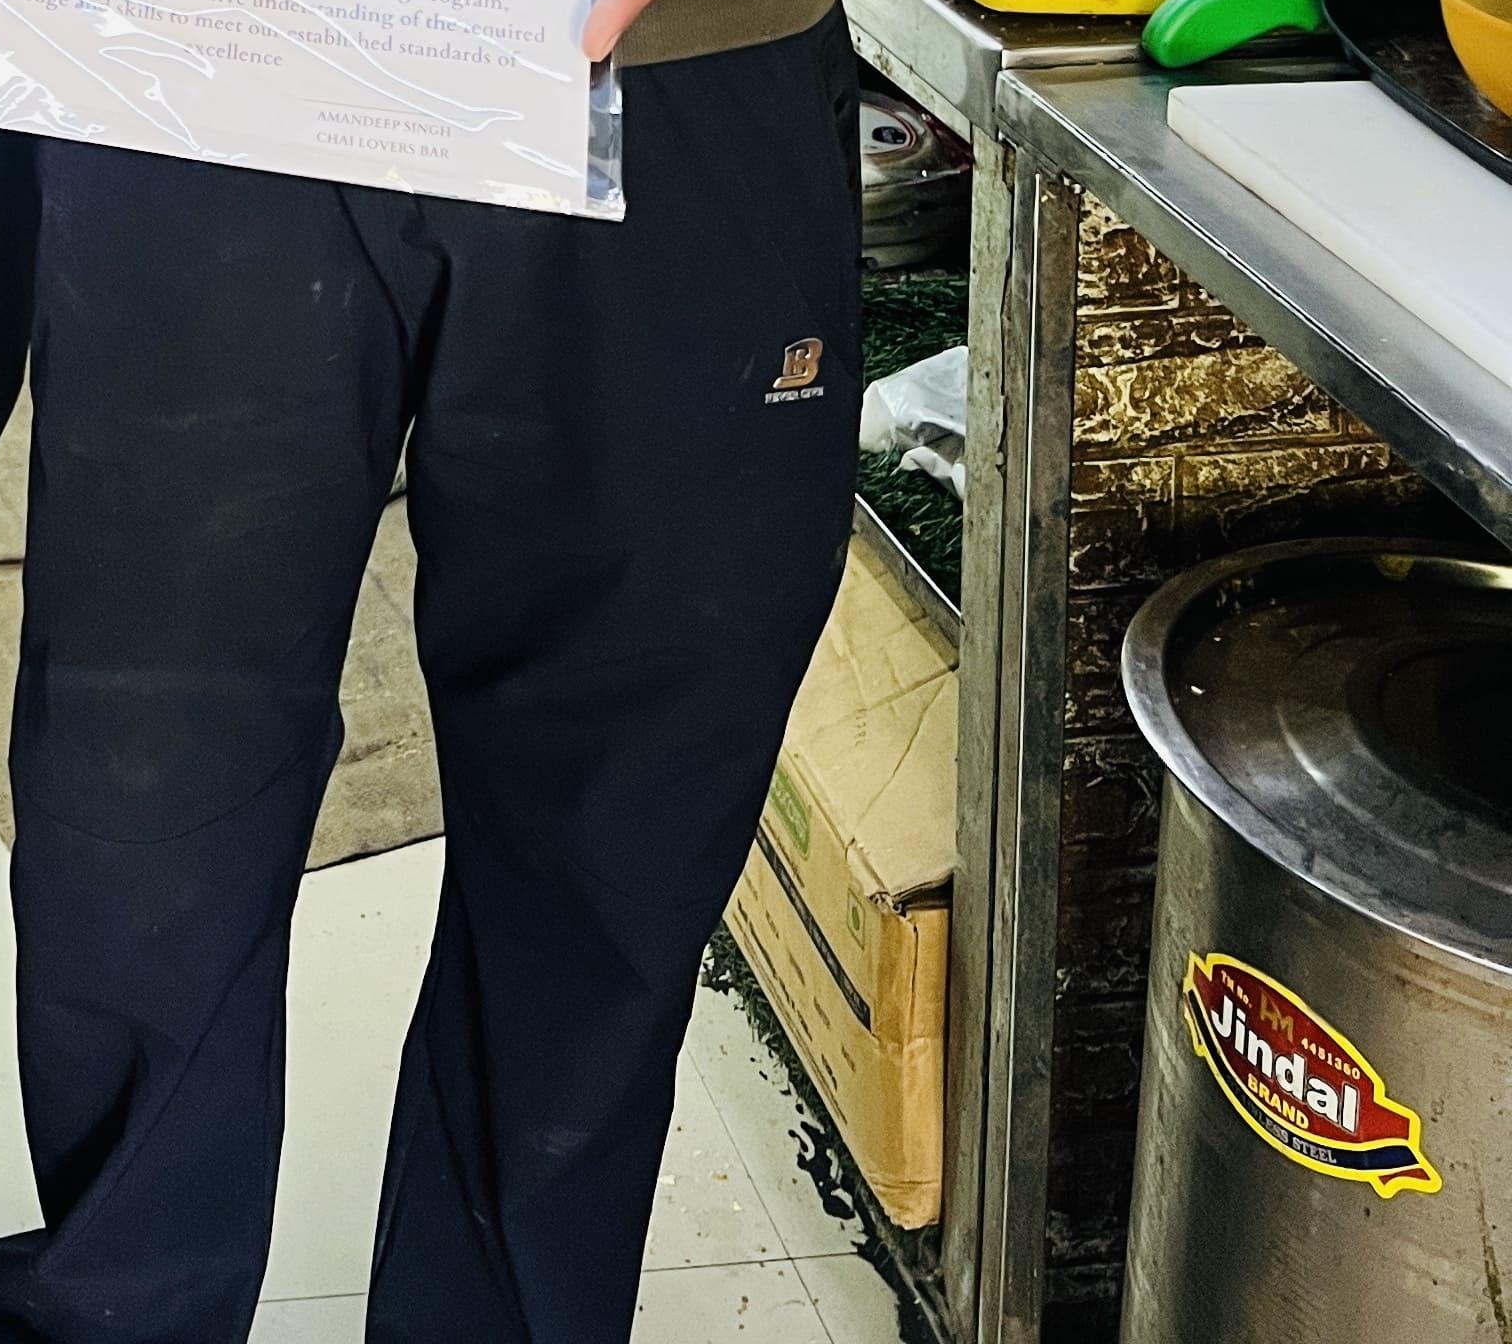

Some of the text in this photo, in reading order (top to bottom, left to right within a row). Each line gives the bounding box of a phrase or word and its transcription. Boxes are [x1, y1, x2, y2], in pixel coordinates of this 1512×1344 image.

[400, 11, 423, 27] of
[426, 15, 457, 33] the
[169, 11, 189, 25] to
[195, 14, 243, 34] meet
[399, 40, 490, 65] standards
[317, 111, 452, 138] AMANDEEP SINGH
[316, 131, 450, 159] CHAI LOVERS BAR
[1210, 994, 1359, 1134] Jindal
[1248, 1072, 1310, 1130] BRAND
[1292, 1136, 1337, 1164] STEEL
